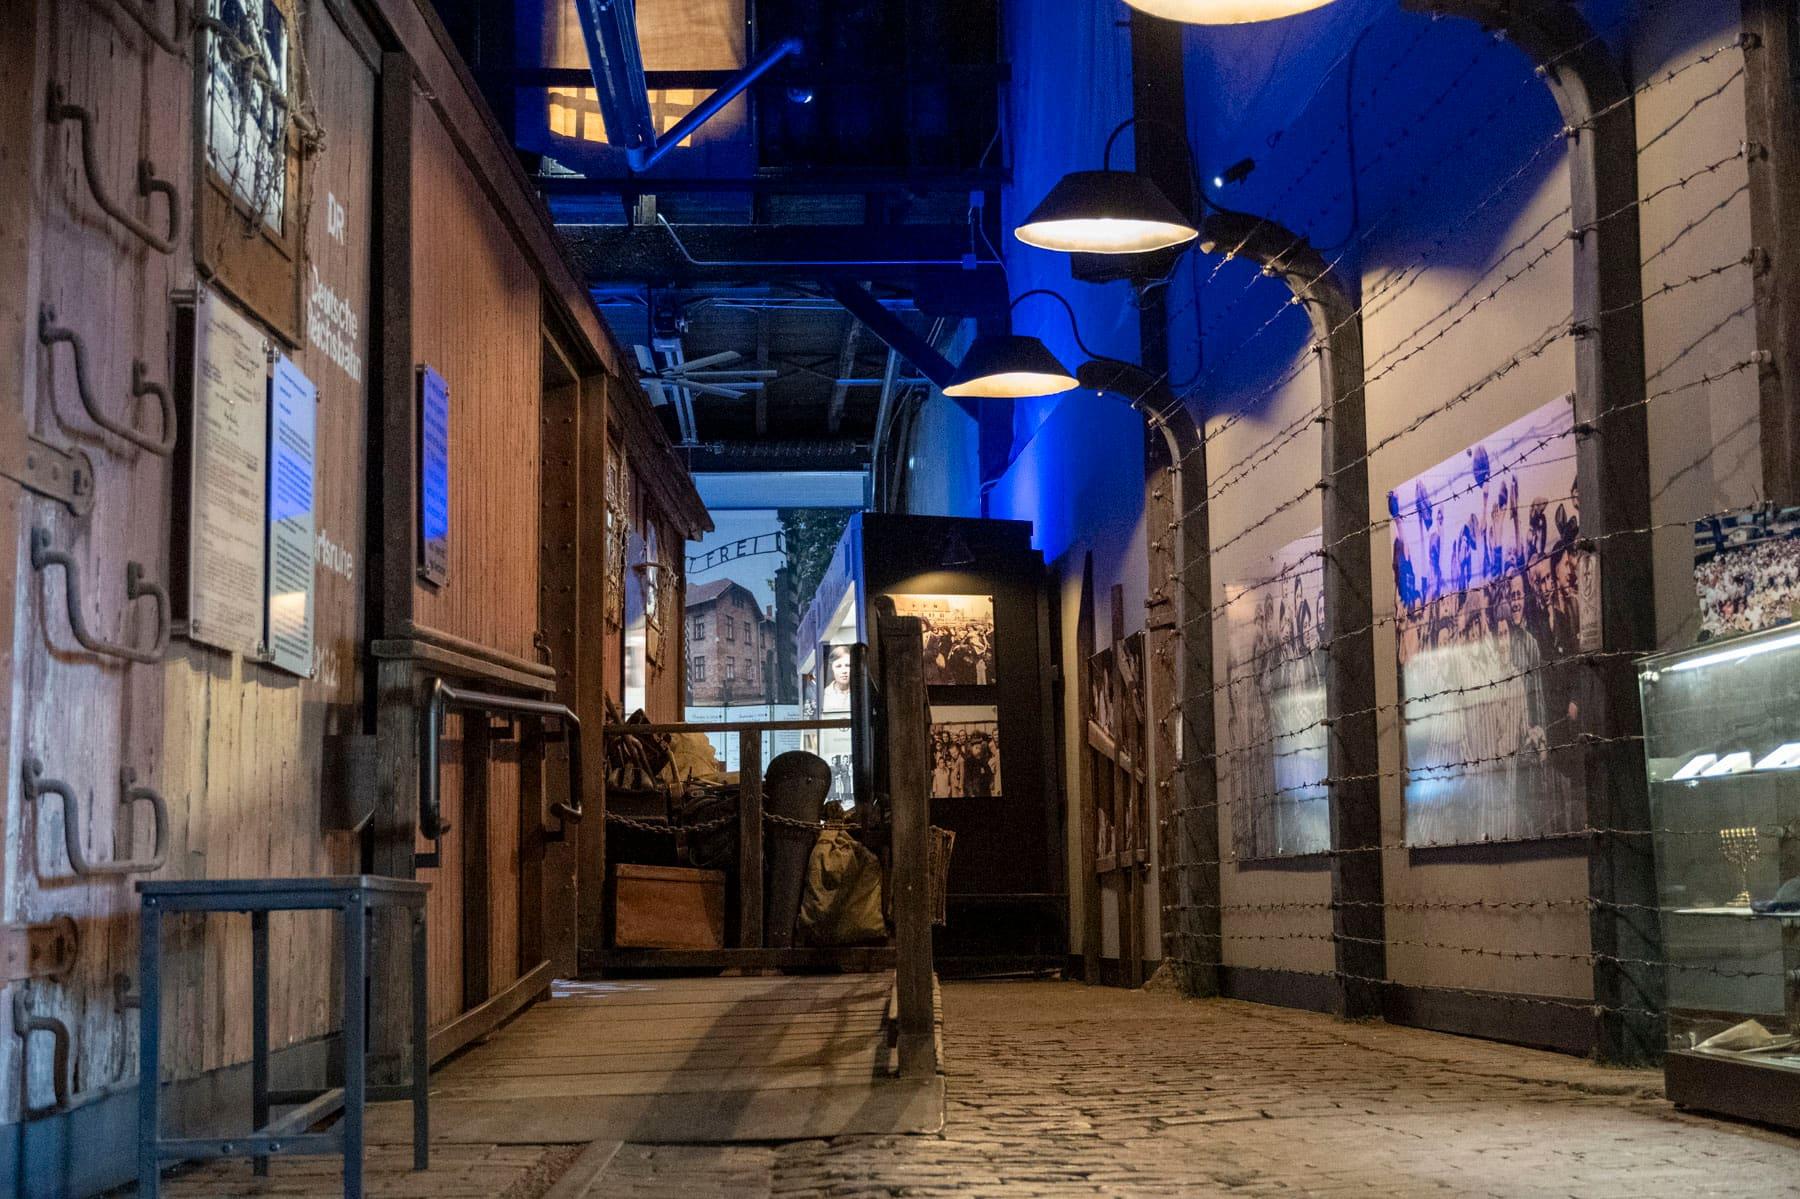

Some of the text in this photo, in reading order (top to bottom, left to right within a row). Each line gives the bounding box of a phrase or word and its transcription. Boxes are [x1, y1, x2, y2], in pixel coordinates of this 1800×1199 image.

[327, 192, 345, 246] DR
[307, 298, 362, 385] Reichsbahn
[705, 536, 758, 569] FREI
